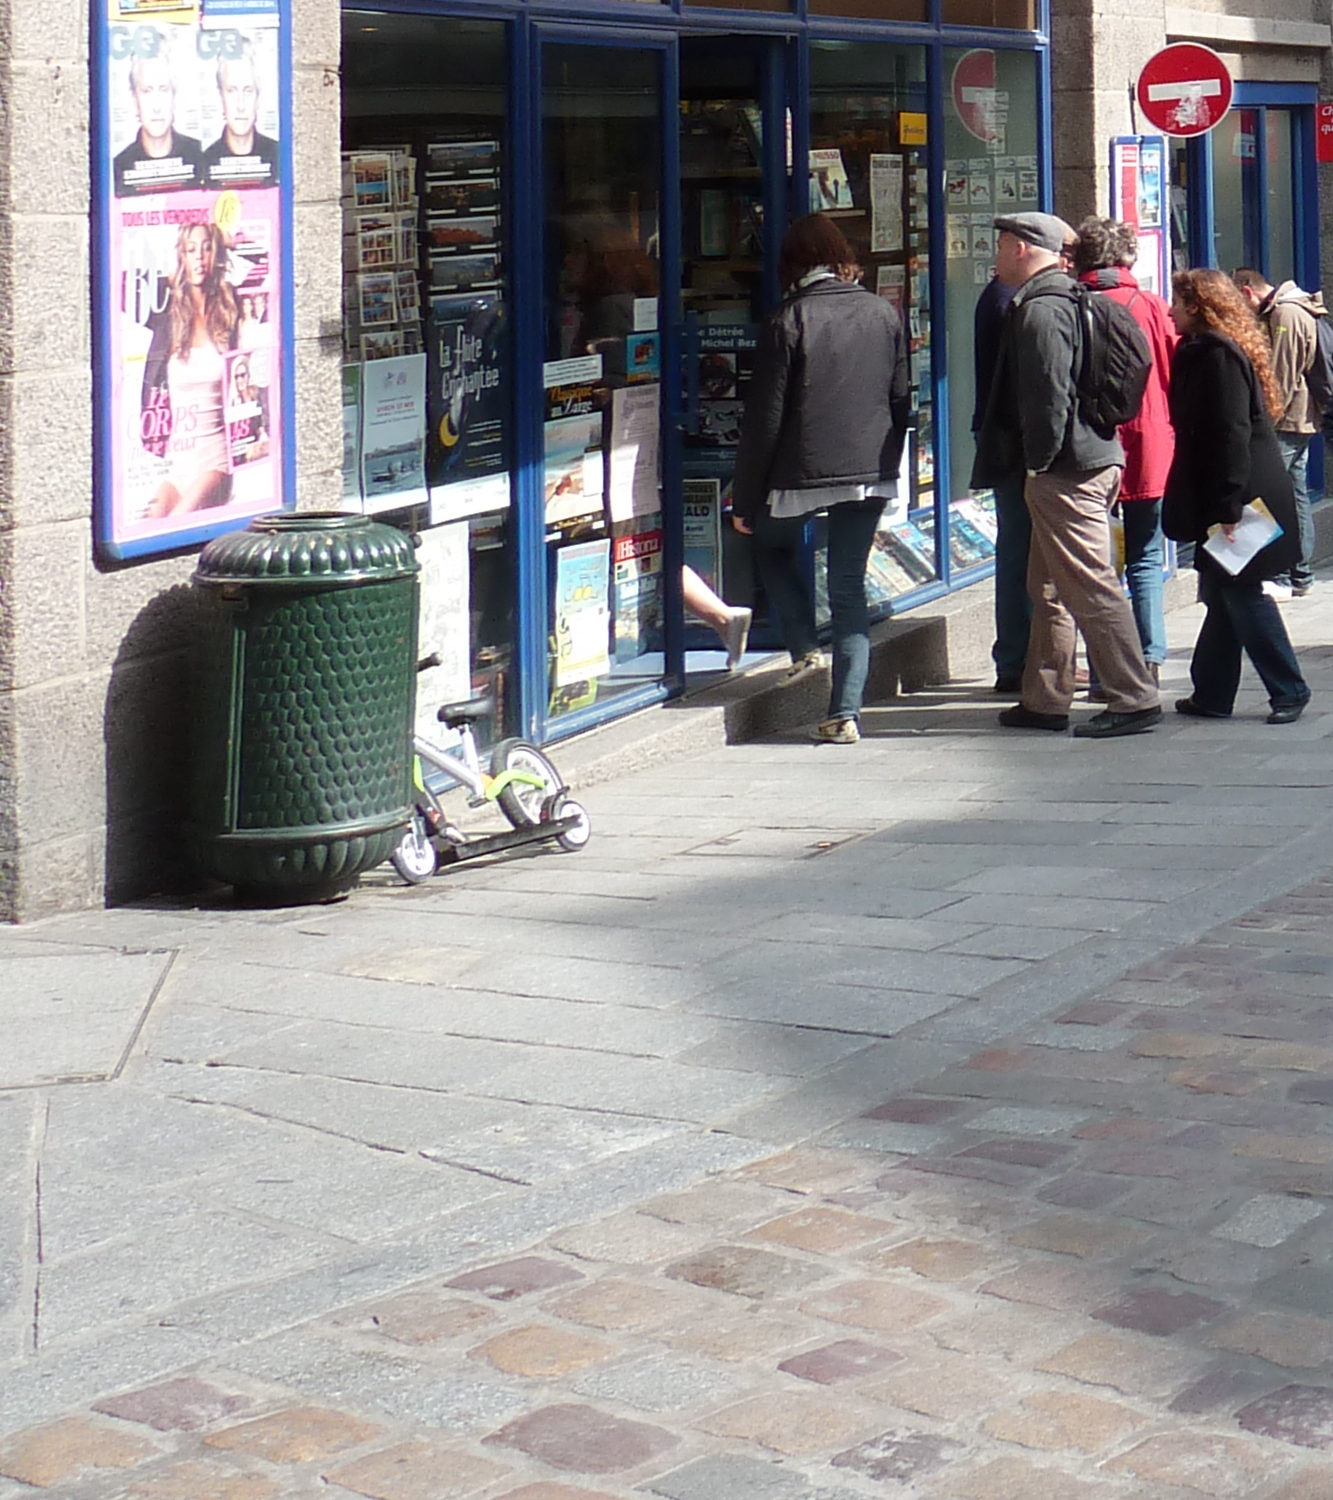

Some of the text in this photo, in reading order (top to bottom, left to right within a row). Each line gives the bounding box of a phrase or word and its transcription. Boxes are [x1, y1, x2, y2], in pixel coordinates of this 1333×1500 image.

[109, 25, 161, 60] GQ
[122, 211, 144, 227] TOUS
[146, 210, 161, 226] LES
[702, 338, 735, 348] Michel
[127, 403, 199, 442] CORPS
